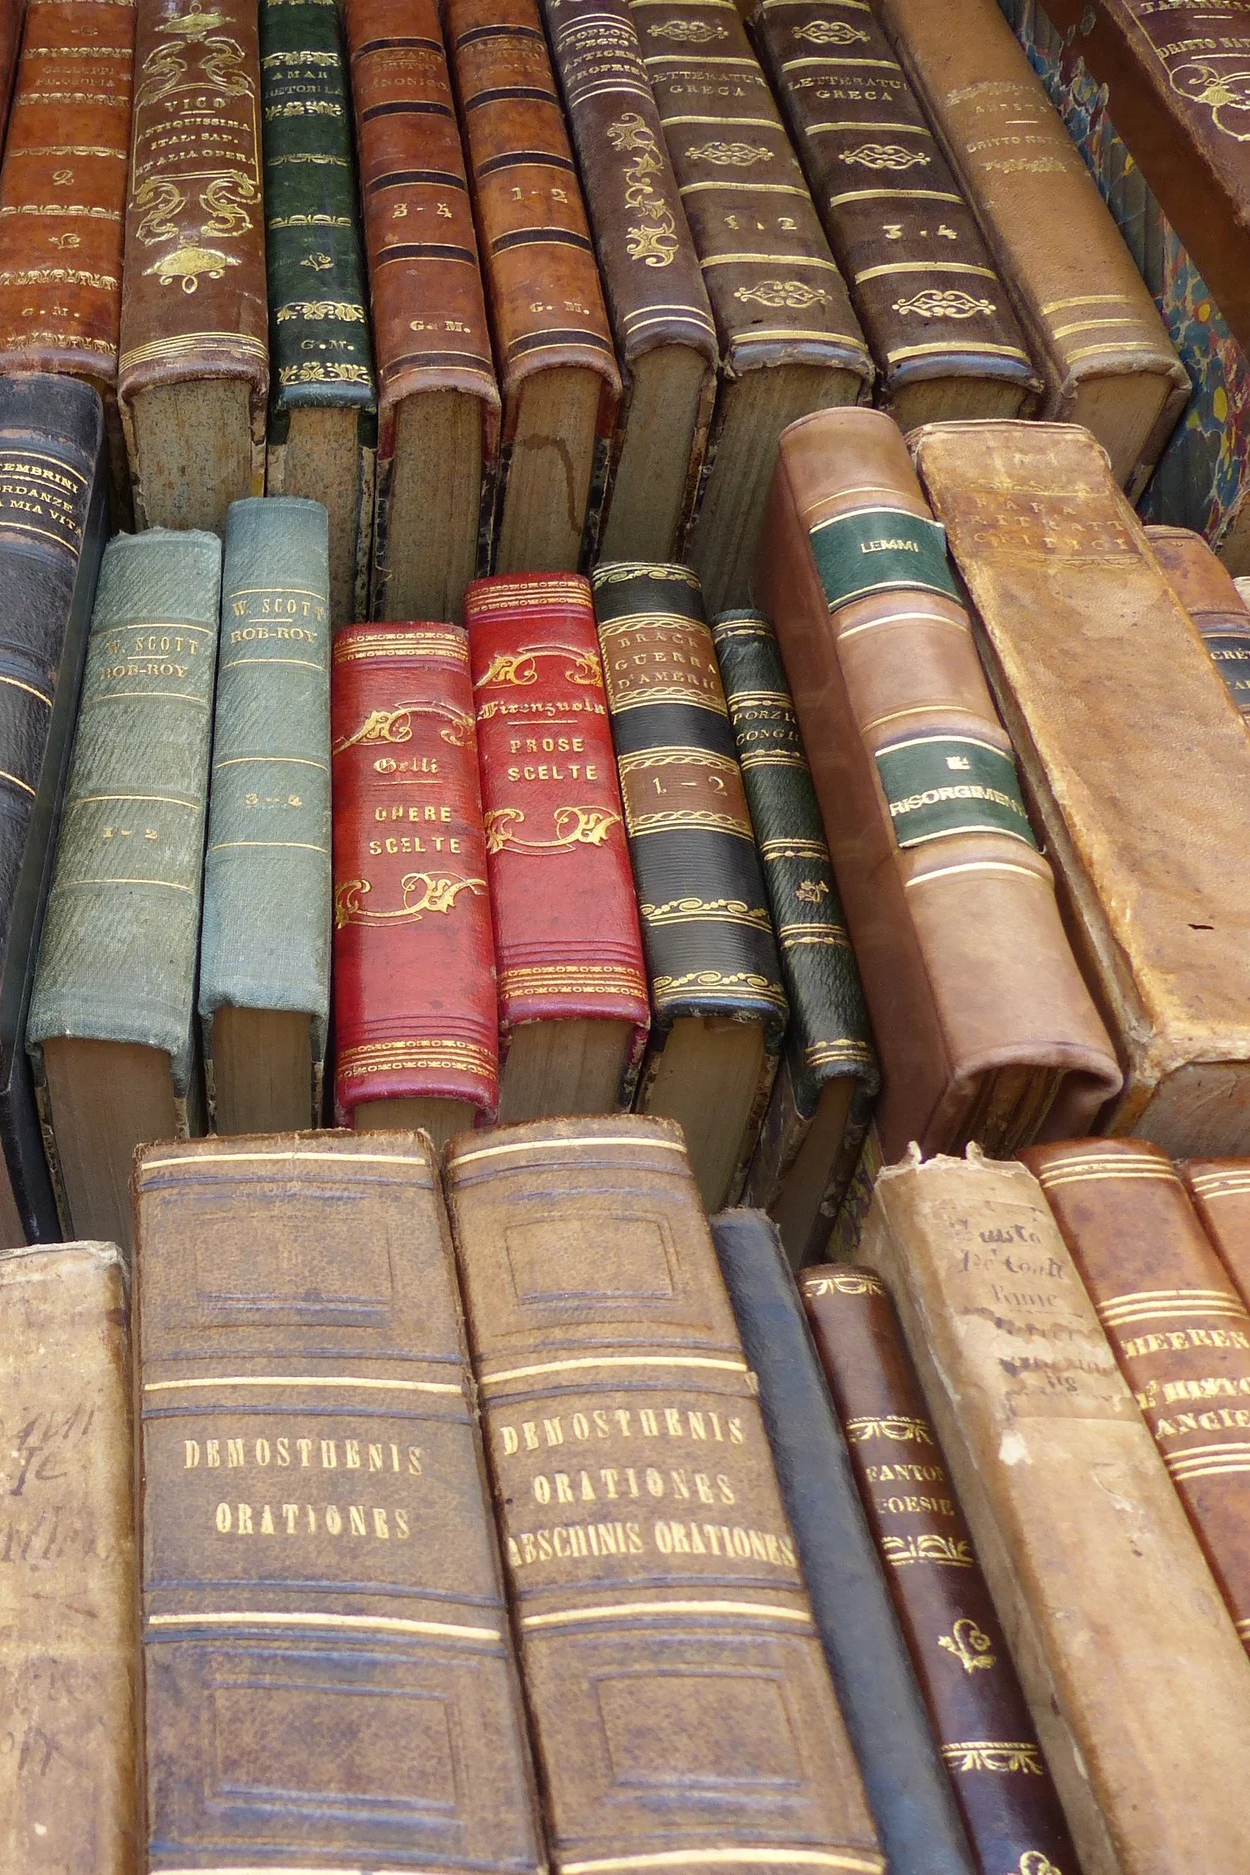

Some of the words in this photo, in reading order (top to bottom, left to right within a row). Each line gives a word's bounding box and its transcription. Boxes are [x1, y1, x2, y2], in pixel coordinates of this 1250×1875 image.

[669, 84, 747, 97] GRECA
[815, 90, 893, 101] GRECA
[164, 96, 227, 112] VICO
[137, 117, 252, 144] ANTIQUISSIMA
[156, 149, 199, 166] ALIA
[201, 149, 256, 165] OPERA
[52, 169, 74, 186] 2
[9, 498, 42, 516] MIA
[861, 538, 920, 554] LEMMI
[262, 598, 325, 621] SCOTT
[230, 628, 318, 644] ROB-ROY
[135, 636, 198, 655] SCOTT
[101, 663, 188, 680] ROB-ROY
[615, 652, 716, 674] GUERRA
[510, 738, 585, 754] PROSE
[507, 764, 599, 782] SCELTE
[374, 806, 452, 823] OPERE
[369, 836, 462, 855] SCELTE
[1120, 1328, 1250, 1359] HEEREN
[500, 1408, 746, 1456] DEMOSTHENIS
[183, 1436, 423, 1475] DEMOSTHENIS
[533, 1466, 736, 1505] ORATIONES
[215, 1502, 410, 1541] ORATIONES
[655, 1520, 798, 1568] ORATIONES
